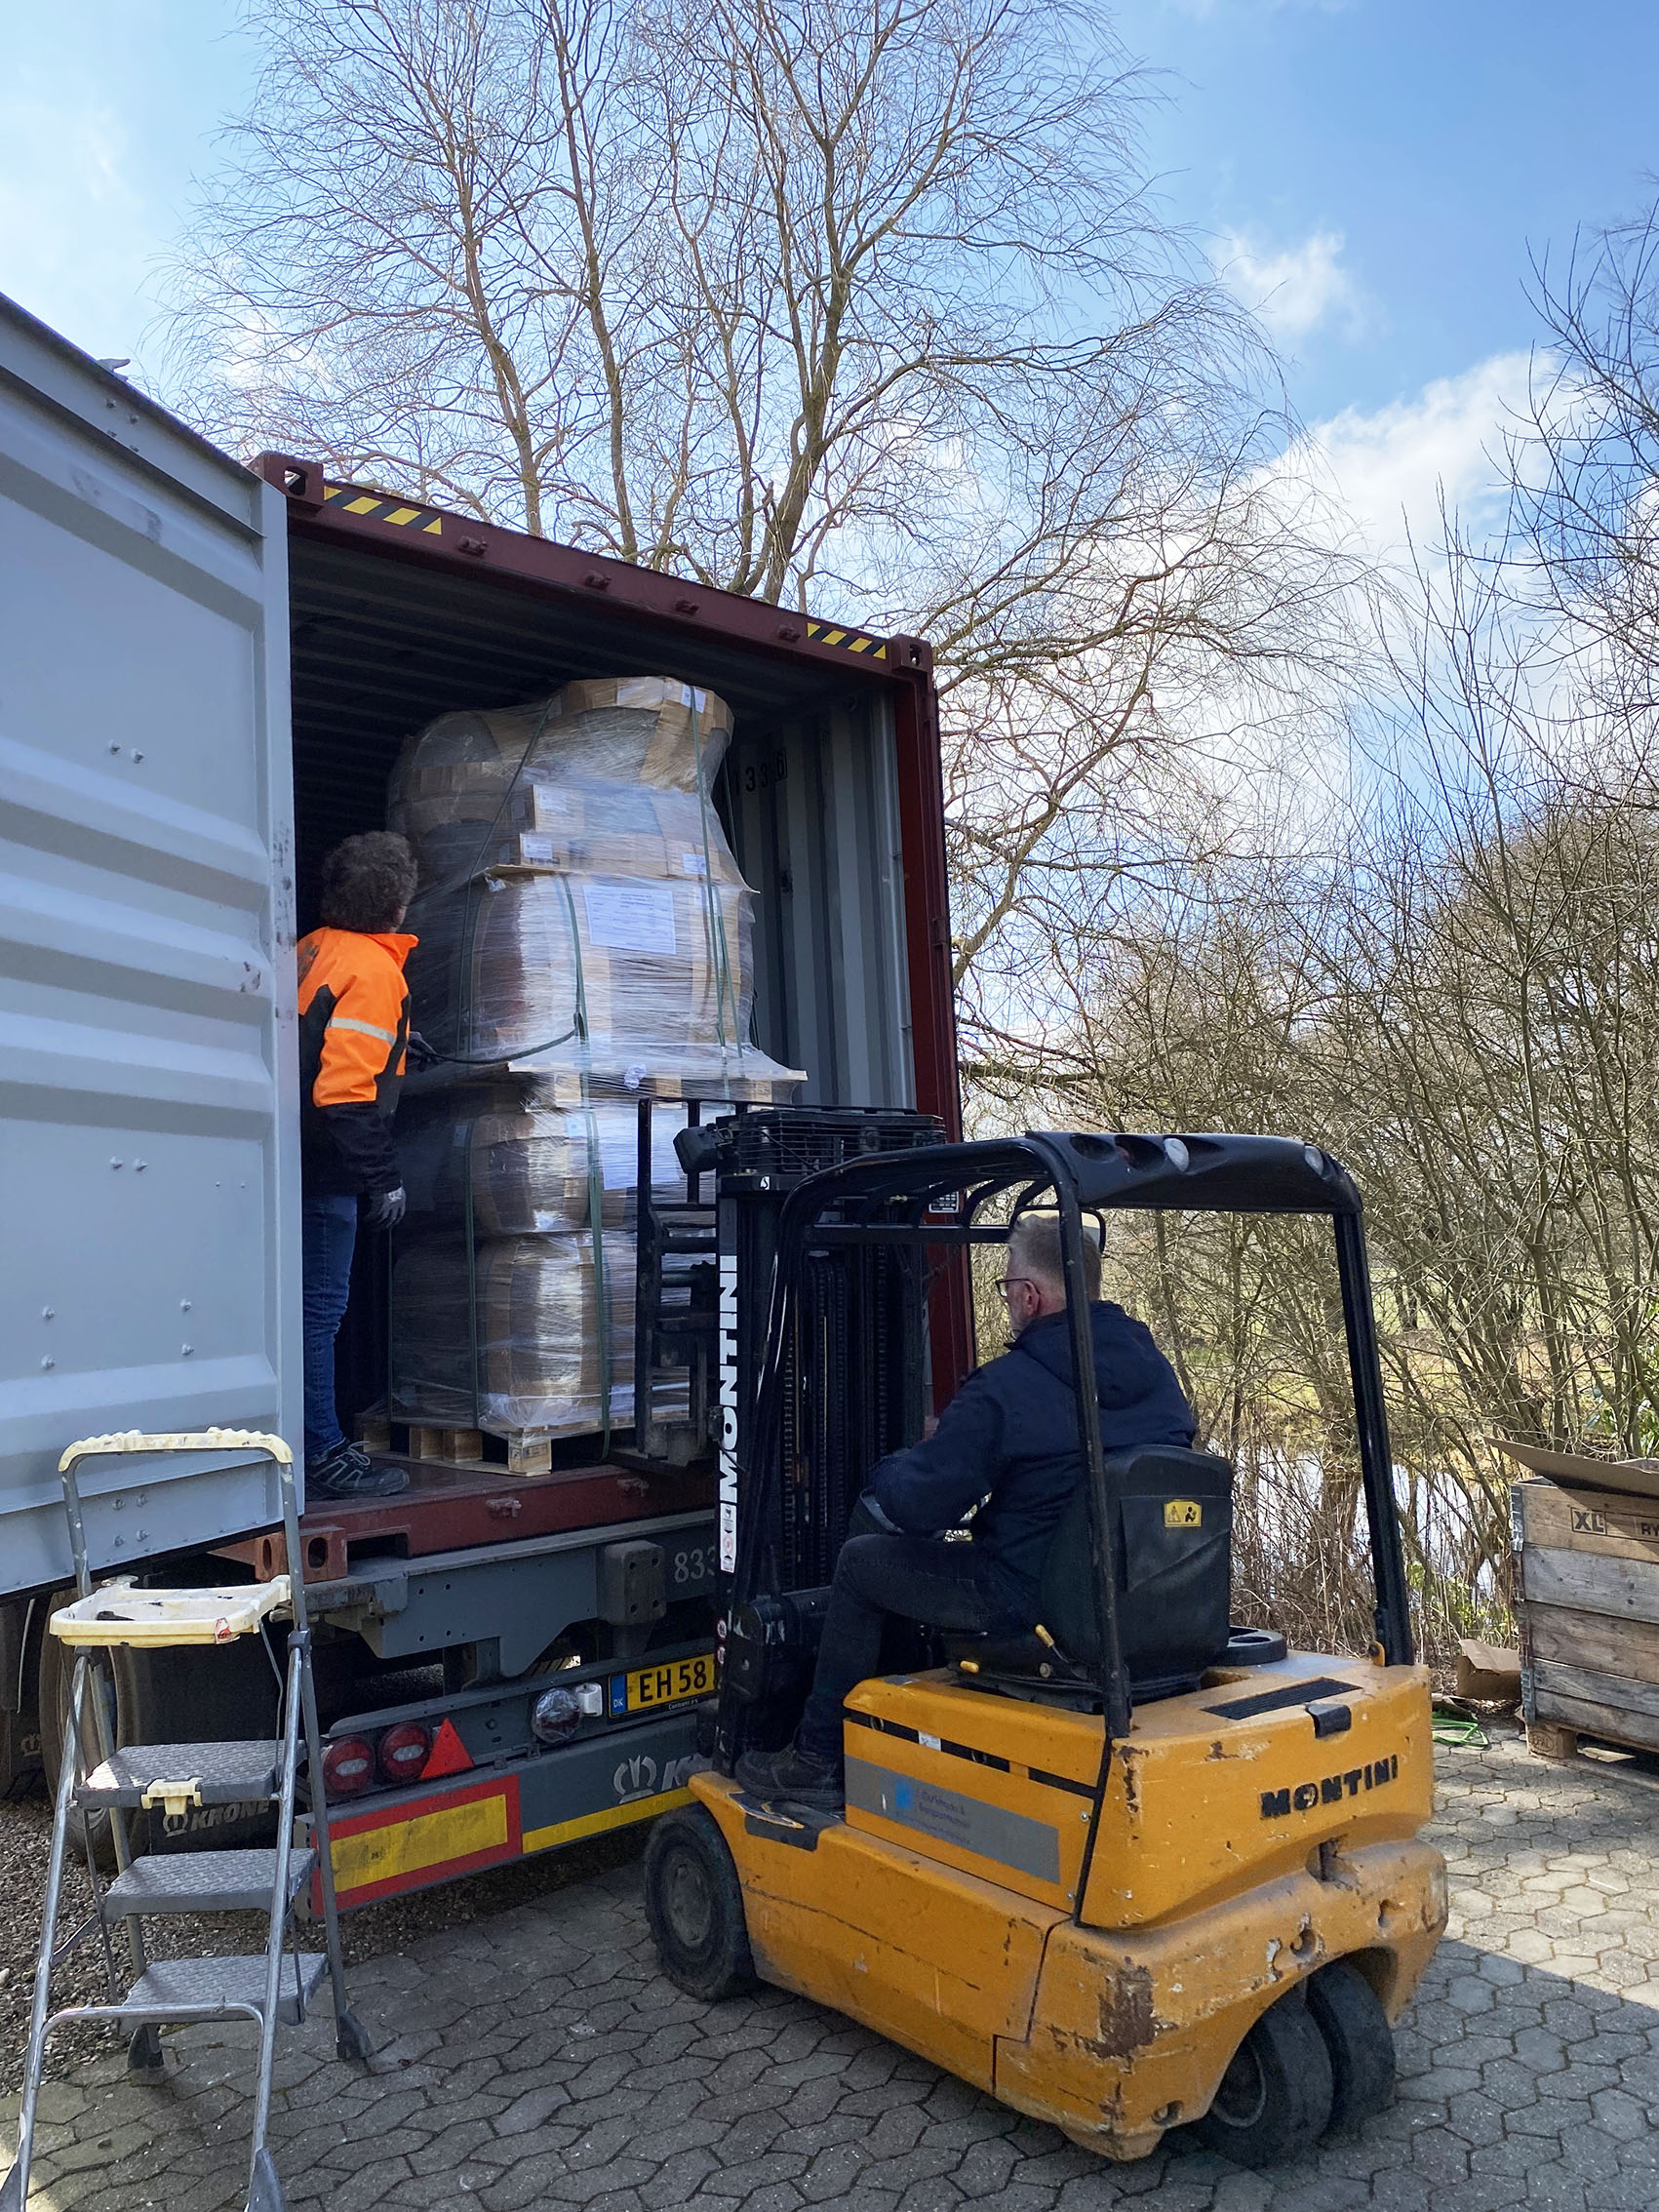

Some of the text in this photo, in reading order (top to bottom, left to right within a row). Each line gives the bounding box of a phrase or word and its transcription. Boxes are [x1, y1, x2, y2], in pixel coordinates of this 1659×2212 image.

[720, 1255, 737, 1504] MONTINI
[1574, 1511, 1604, 1532] XL
[612, 1660, 706, 1709] DK EH 58
[1260, 1754, 1399, 1819] MONTINI
[189, 1800, 270, 1833] KRONE
